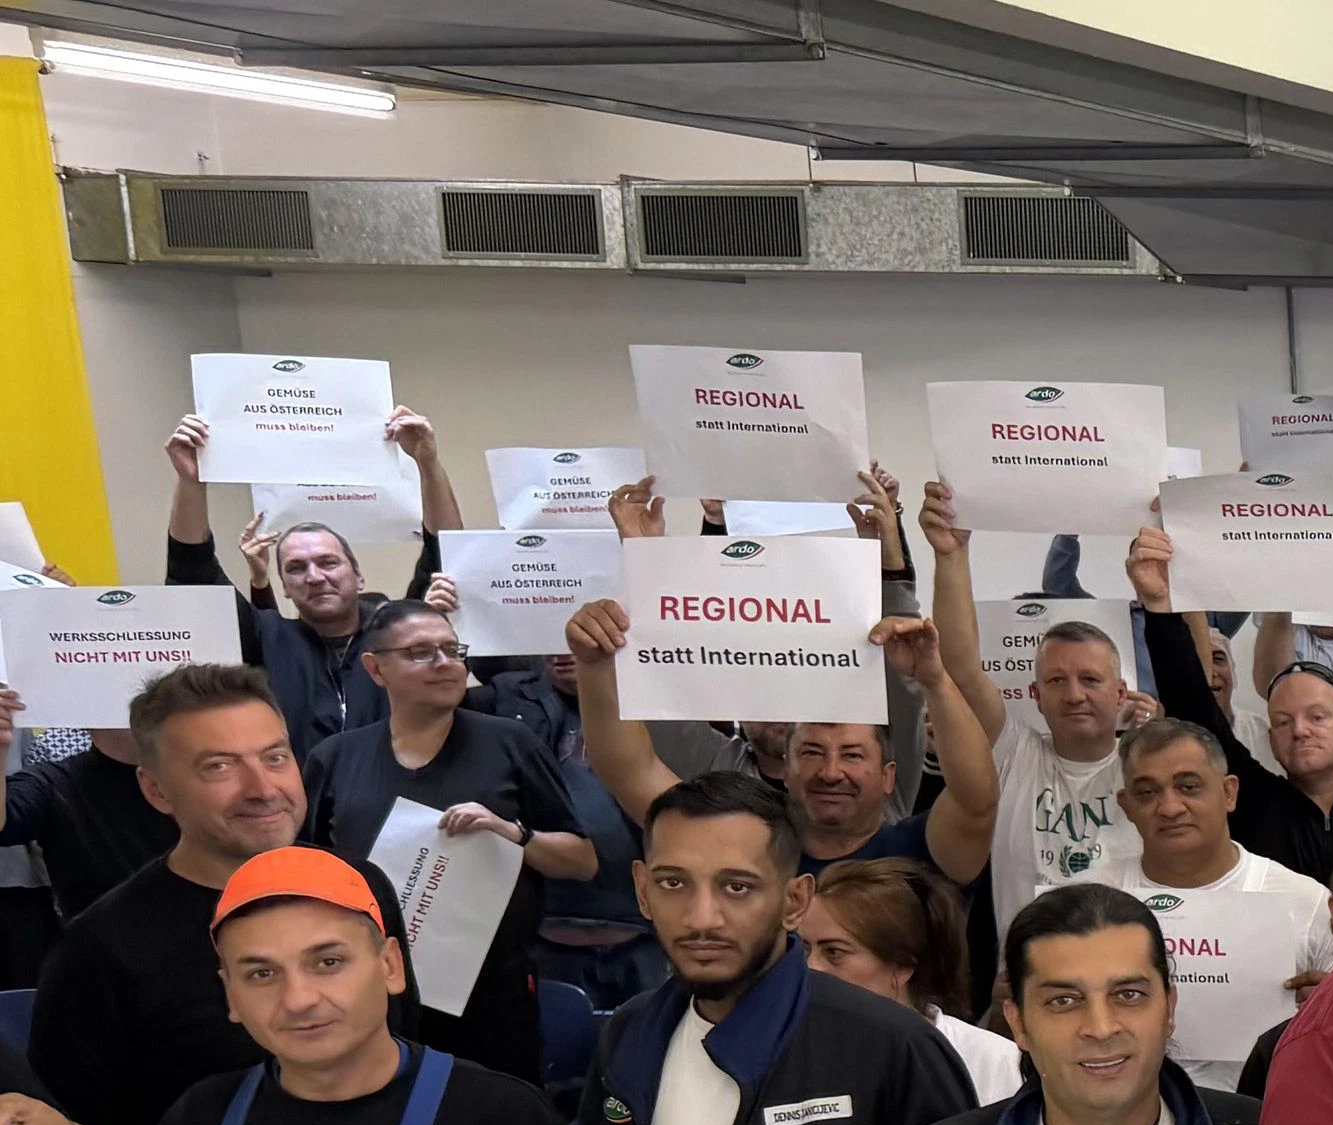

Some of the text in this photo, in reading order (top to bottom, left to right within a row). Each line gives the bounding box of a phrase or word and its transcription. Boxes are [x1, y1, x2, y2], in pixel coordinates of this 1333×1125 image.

[268, 389, 315, 398] GEMÜSE
[695, 389, 804, 409] REGIONAL
[244, 404, 342, 415] AUS ÖSTERREICH
[1273, 414, 1333, 425] REGIONAL
[289, 423, 333, 431] bleiben!
[696, 420, 808, 433] statt International
[992, 424, 1104, 442] REGIONAL
[992, 456, 1107, 466] statt International
[550, 476, 591, 485] GEMÜSE
[1222, 504, 1333, 517] REGIONAL
[1222, 532, 1251, 540] statt
[512, 562, 557, 572] GEMÜSE
[491, 579, 582, 588] AUS ÖSTERREICH
[661, 596, 831, 623] REGIONAL
[49, 631, 191, 642] WERKSSCHLIESSUNG
[55, 650, 191, 663] NICHT MIT UNS!!
[638, 646, 860, 667] statt International
[1036, 788, 1113, 842] GAN
[416, 855, 450, 916] MIT UNS!!
